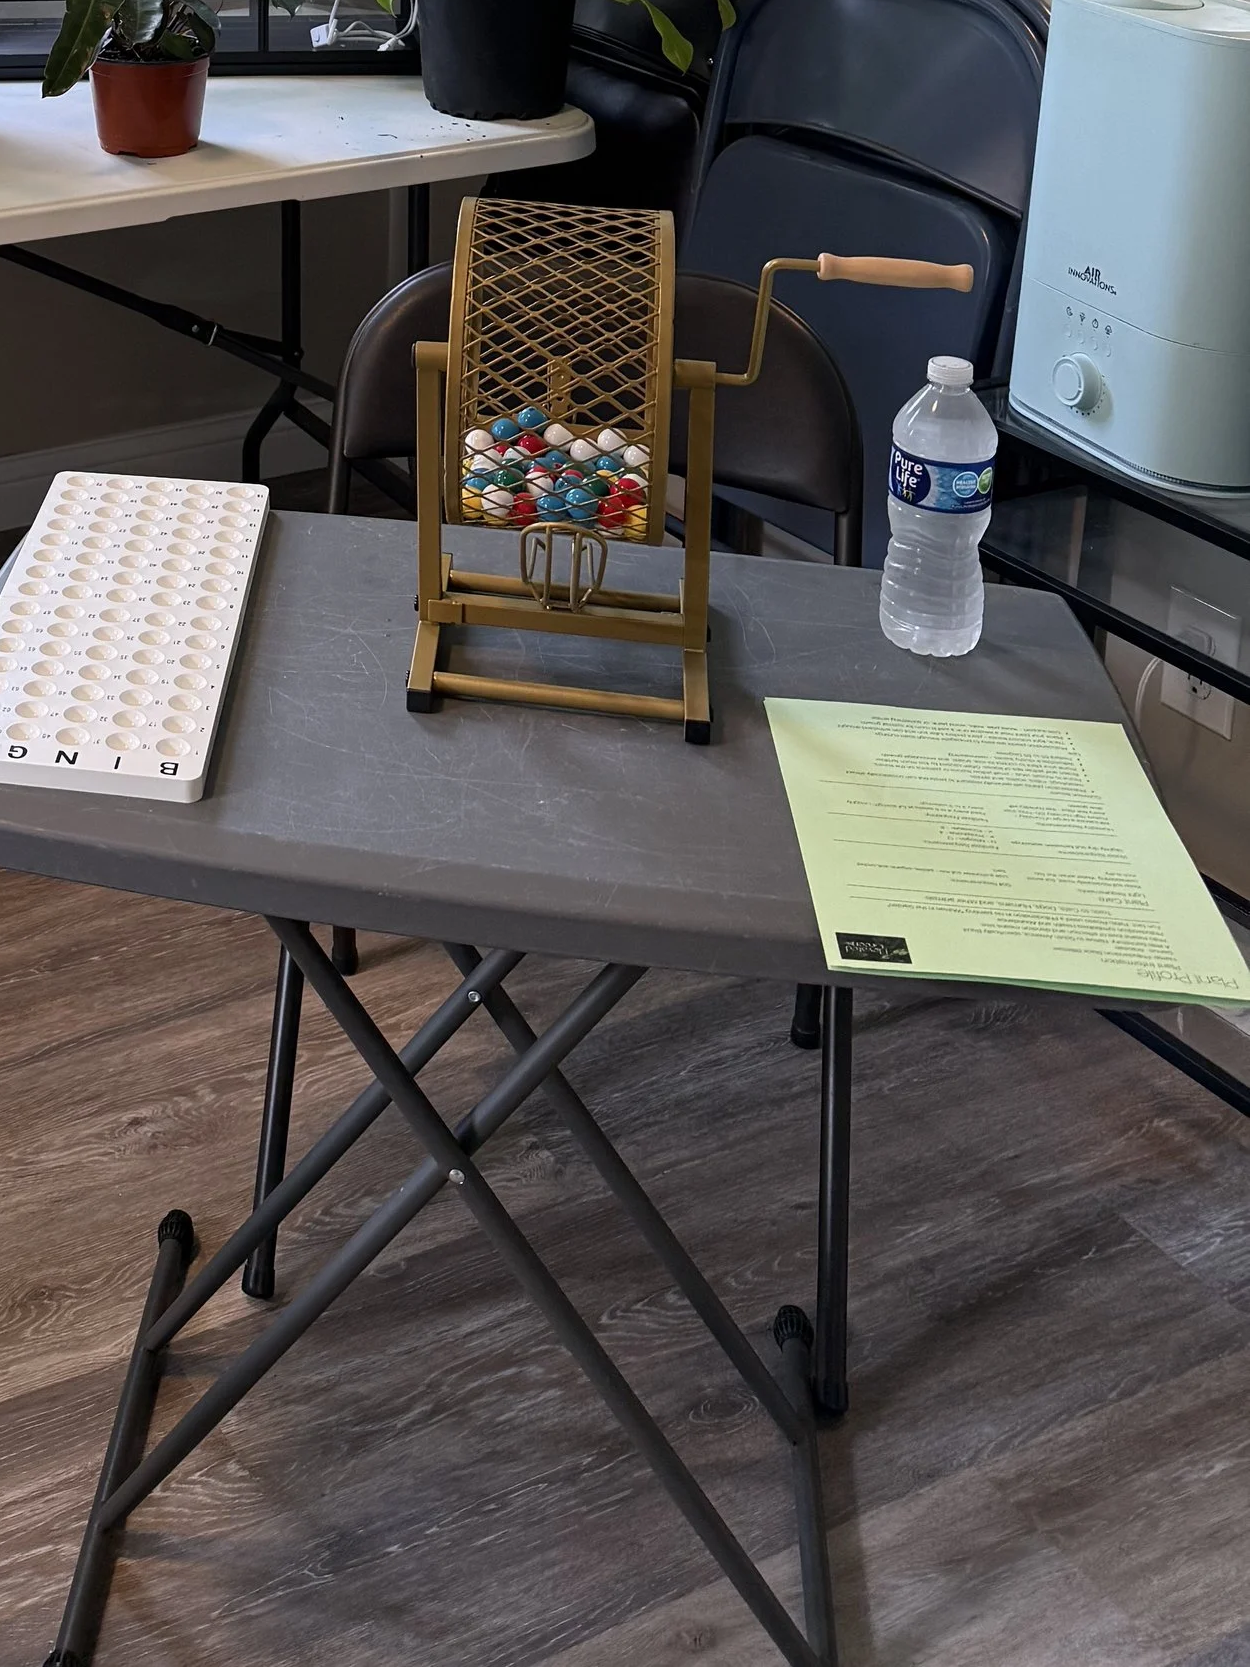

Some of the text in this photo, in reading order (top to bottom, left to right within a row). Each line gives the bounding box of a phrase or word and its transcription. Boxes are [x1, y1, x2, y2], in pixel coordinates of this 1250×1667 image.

[1084, 265, 1101, 282] AIR
[895, 451, 923, 475] Pure
[896, 466, 917, 488] Life
[7, 745, 28, 760] G
[54, 750, 79, 765] N
[114, 756, 122, 770] I
[160, 762, 179, 776] B
[1136, 968, 1238, 989] Plant Profile
